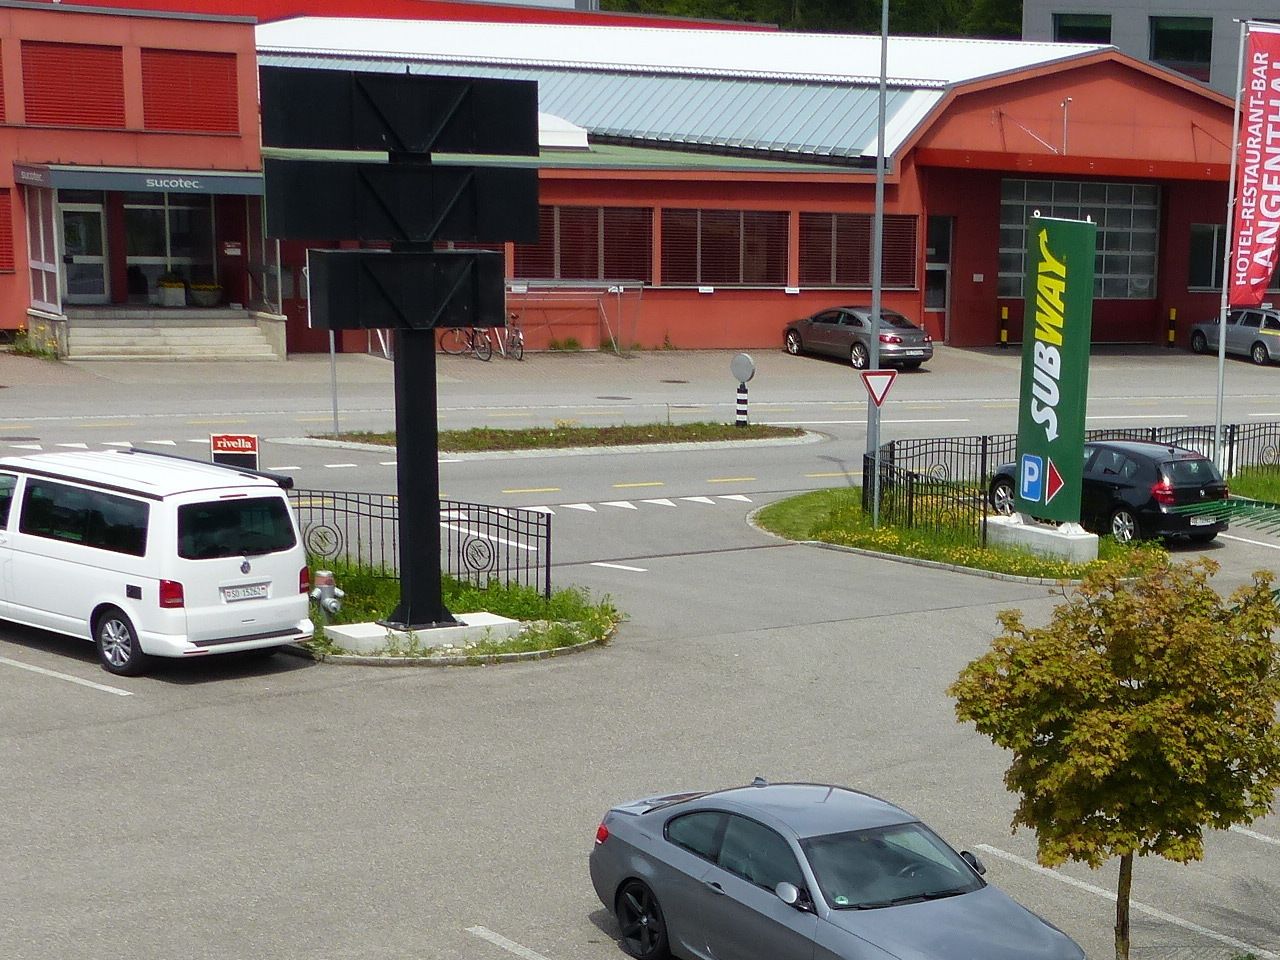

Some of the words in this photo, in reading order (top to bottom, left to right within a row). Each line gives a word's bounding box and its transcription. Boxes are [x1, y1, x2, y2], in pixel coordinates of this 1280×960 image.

[146, 178, 200, 190] sucotec
[1235, 52, 1269, 286] HOTEL-RESTAURANT-BAR
[1030, 228, 1067, 442] SUBWAY
[217, 438, 252, 449] rivella
[1024, 459, 1039, 493] P
